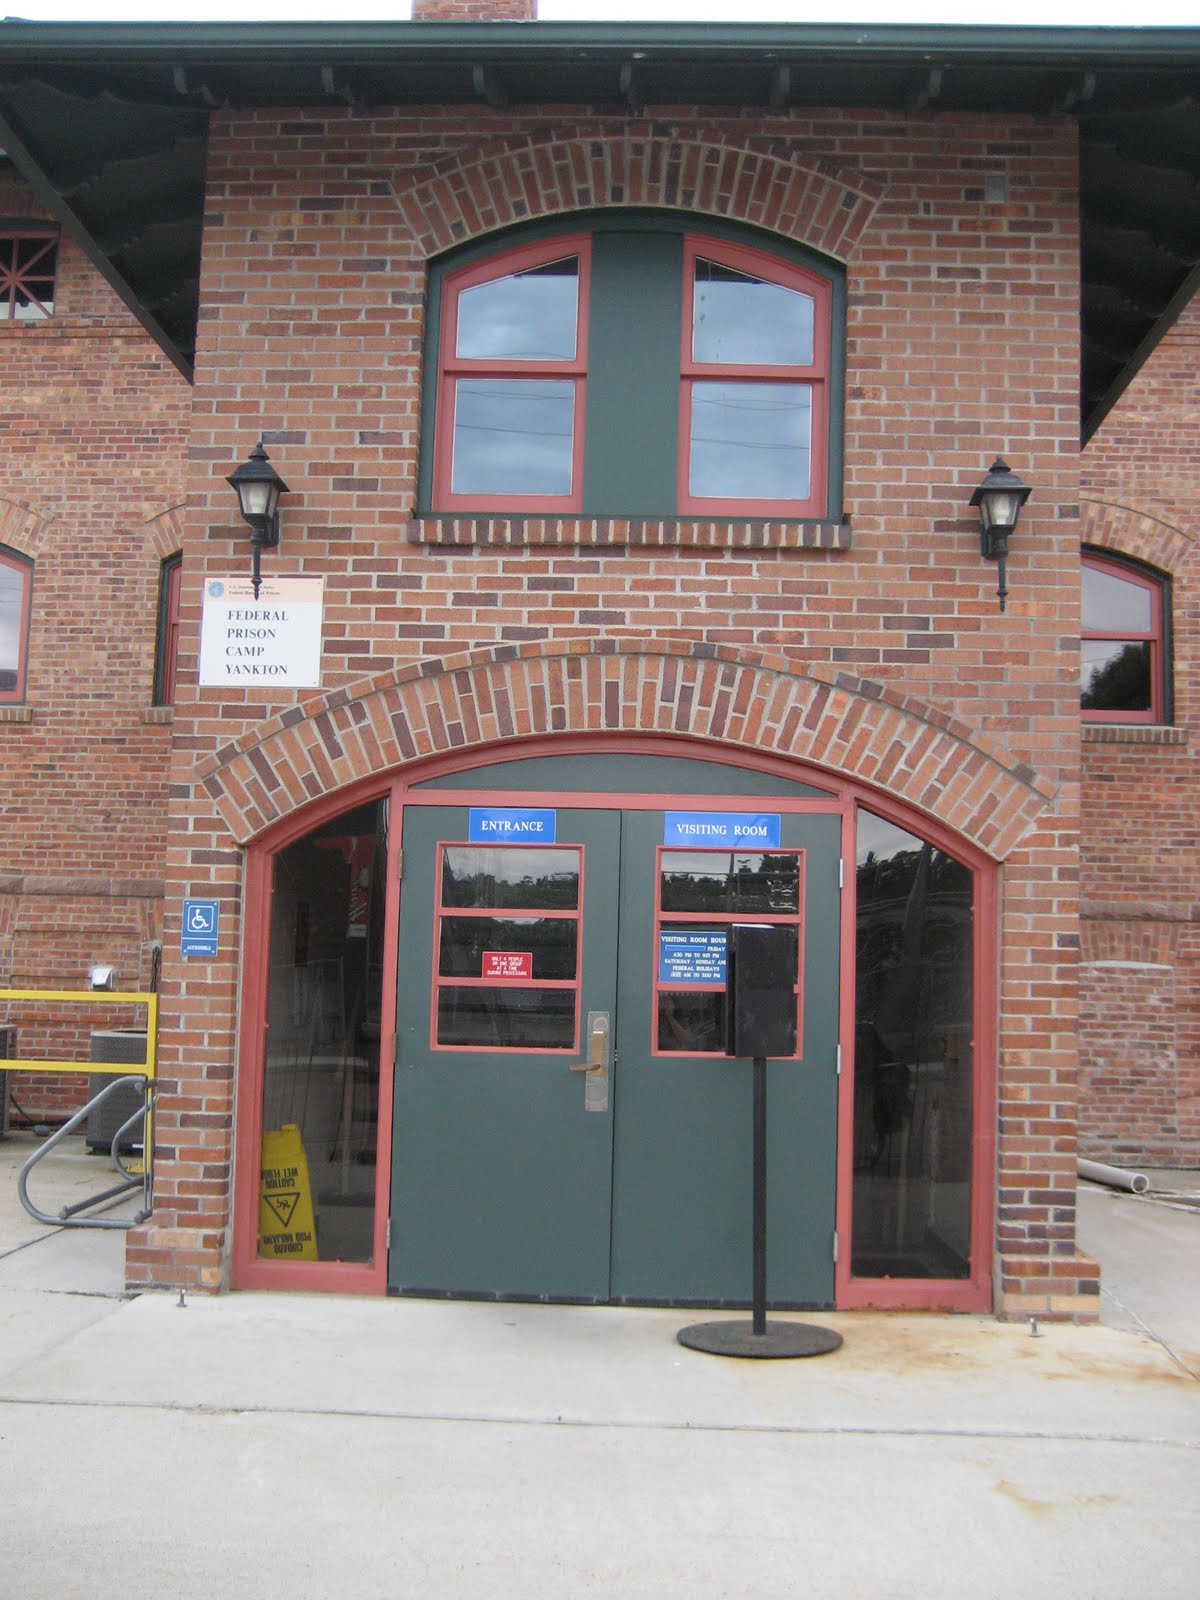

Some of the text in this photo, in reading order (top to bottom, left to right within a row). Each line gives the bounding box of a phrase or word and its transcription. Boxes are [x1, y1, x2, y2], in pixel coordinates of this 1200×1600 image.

[228, 610, 288, 621] FEDERAL
[227, 628, 276, 638] PRISON
[226, 646, 265, 656] CAMP
[226, 664, 288, 675] YANKTON
[481, 820, 544, 832] ENTRANCE
[676, 824, 768, 836] VISITING ROOM
[284, 1168, 298, 1178] WET
[266, 1178, 295, 1189] CAUTION
[264, 1232, 312, 1245] PISO MOJADO
[274, 1242, 303, 1254] CUIDADO
